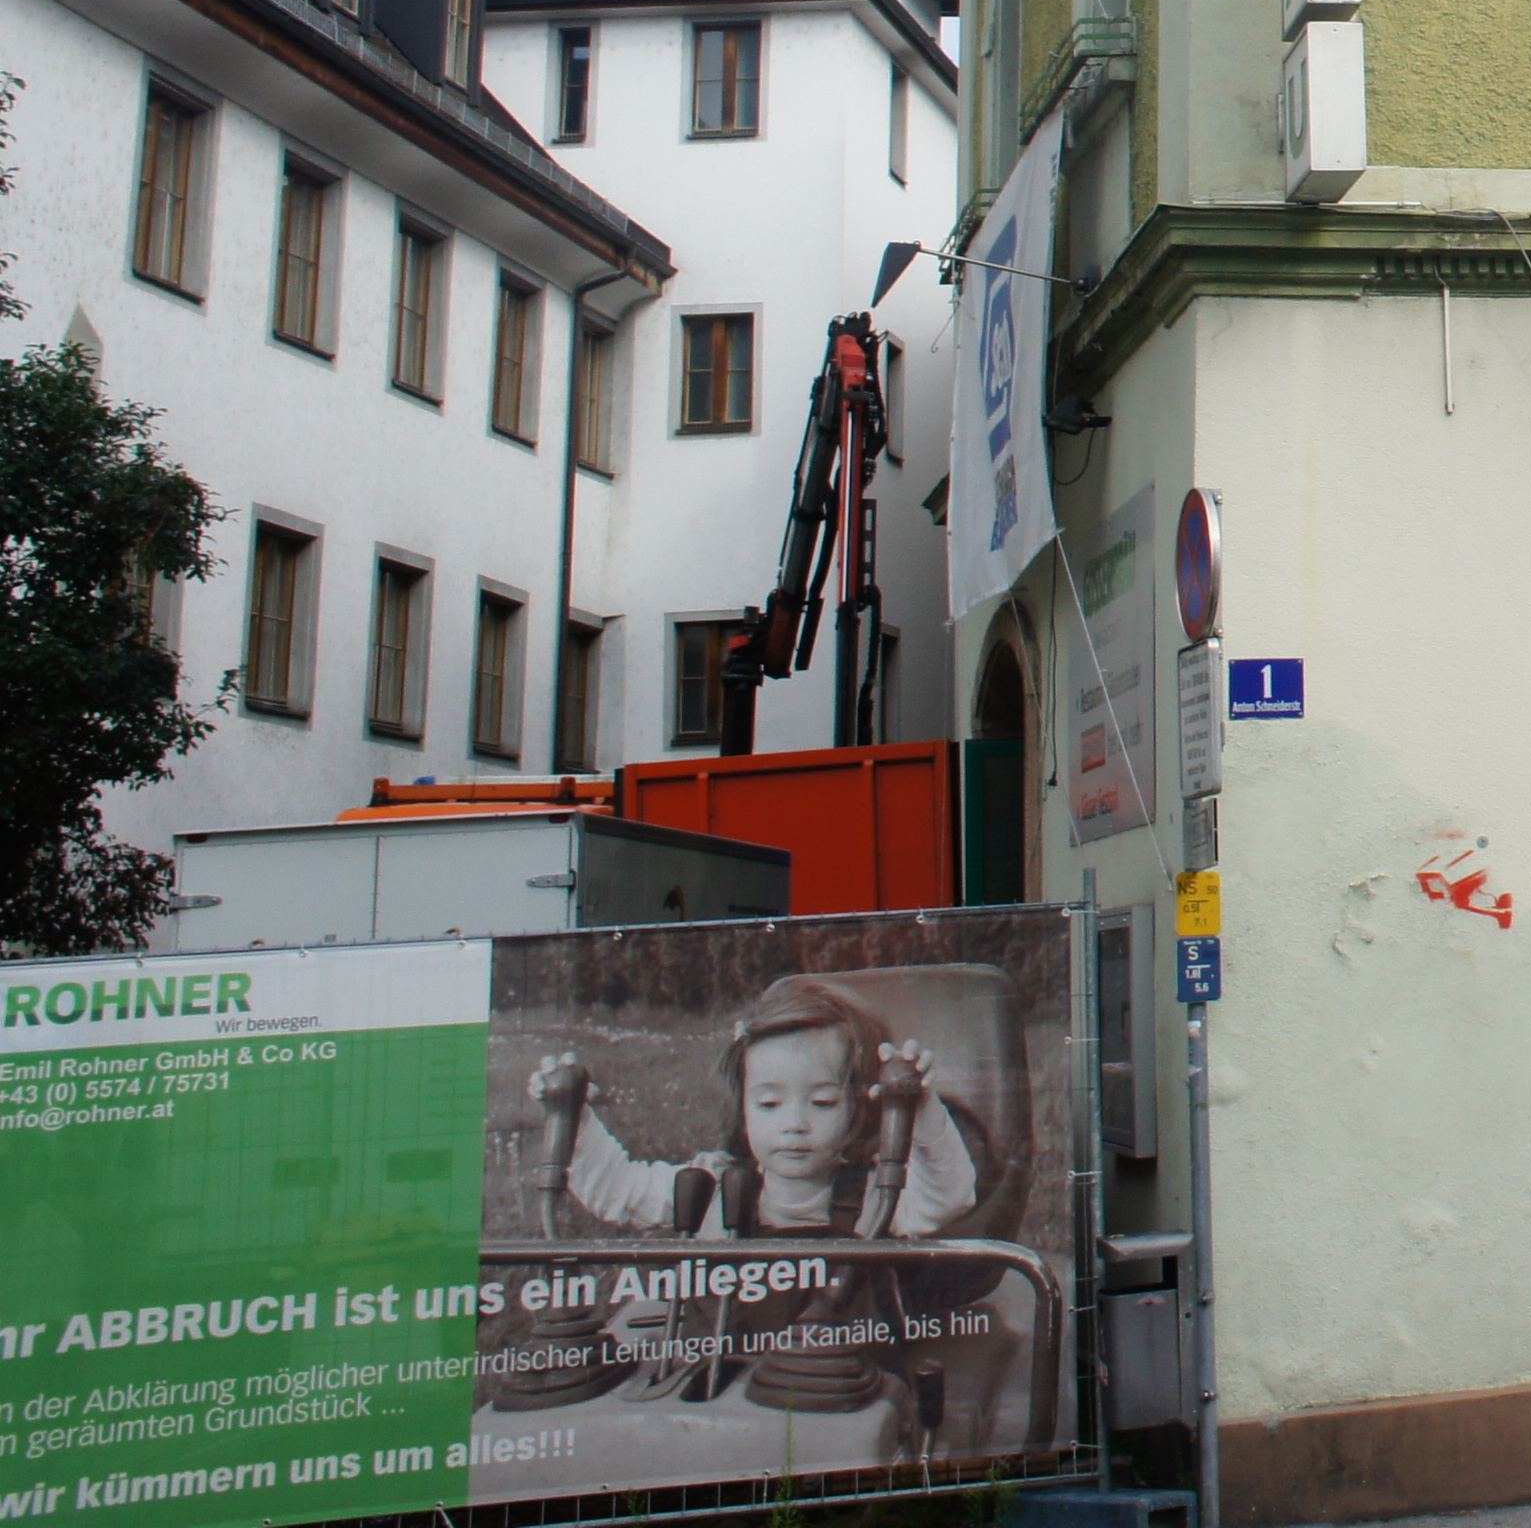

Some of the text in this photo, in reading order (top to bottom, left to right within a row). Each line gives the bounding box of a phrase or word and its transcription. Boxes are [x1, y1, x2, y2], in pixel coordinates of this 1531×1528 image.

[1261, 664, 1272, 698] 1
[1177, 881, 1197, 895] NS
[1188, 946, 1199, 961] S
[5, 971, 253, 1028] ROHNER
[216, 1015, 322, 1034] Wir bewegen.
[0, 1041, 337, 1082] Emil Rohner GmbH & Co KG
[46, 1082, 77, 1106] (0)
[85, 1077, 141, 1099] 5574
[147, 1076, 156, 1095] /
[163, 1071, 230, 1093] 75731
[0, 1099, 175, 1132] nfo@rohner.at
[56, 1292, 317, 1354] ABBRUCH
[334, 1284, 399, 1327] ist
[415, 1280, 505, 1320] uns
[521, 1270, 596, 1311] ein
[609, 1257, 839, 1304] Anliegen.
[25, 1394, 76, 1422] der
[83, 1379, 236, 1414] Abklärung
[245, 1362, 390, 1398] möglicher
[399, 1343, 593, 1383] unterirdischer
[601, 1331, 733, 1366] Leitungen
[743, 1324, 791, 1352] und
[801, 1318, 896, 1349] Kanäle,
[904, 1314, 941, 1341] bis
[951, 1310, 989, 1335] hin
[26, 1413, 194, 1459] geräumten
[205, 1391, 372, 1432] Grundstück
[0, 1429, 575, 1520] wir kümmern uns um alles!!!
